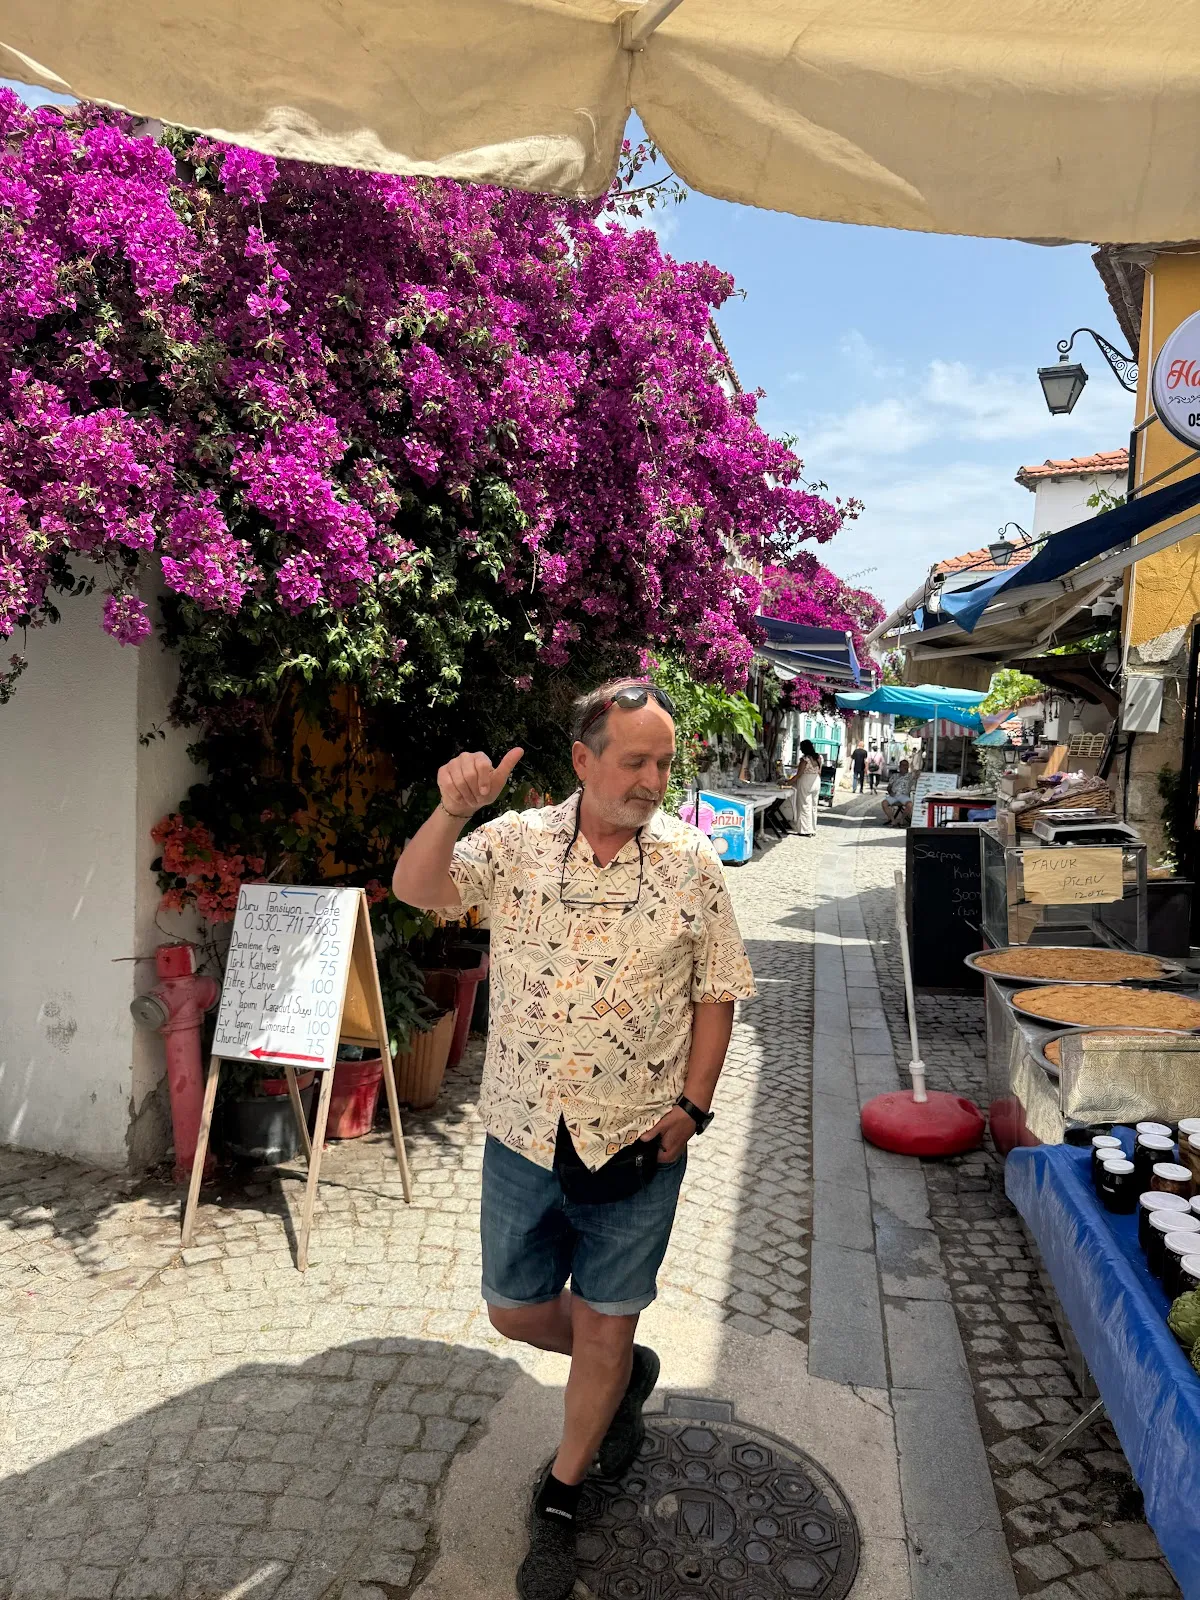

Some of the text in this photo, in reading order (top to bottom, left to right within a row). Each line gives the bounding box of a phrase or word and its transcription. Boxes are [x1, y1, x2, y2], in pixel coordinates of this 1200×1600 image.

[238, 890, 259, 911] Duru
[266, 891, 302, 917] Pansiyon
[314, 895, 340, 917] Cafe
[266, 933, 281, 954] Çay
[320, 940, 341, 957] 25
[249, 951, 278, 971] Kahvesi
[319, 960, 339, 977] 75
[248, 971, 276, 991] Kahve
[311, 979, 334, 994] 100
[221, 988, 232, 1007] Ev
[314, 1000, 337, 1018] 100
[218, 1008, 230, 1027] Ev
[259, 1013, 296, 1034] Limonata
[307, 1020, 330, 1036] 100
[215, 1028, 325, 1055] Churchill 75
